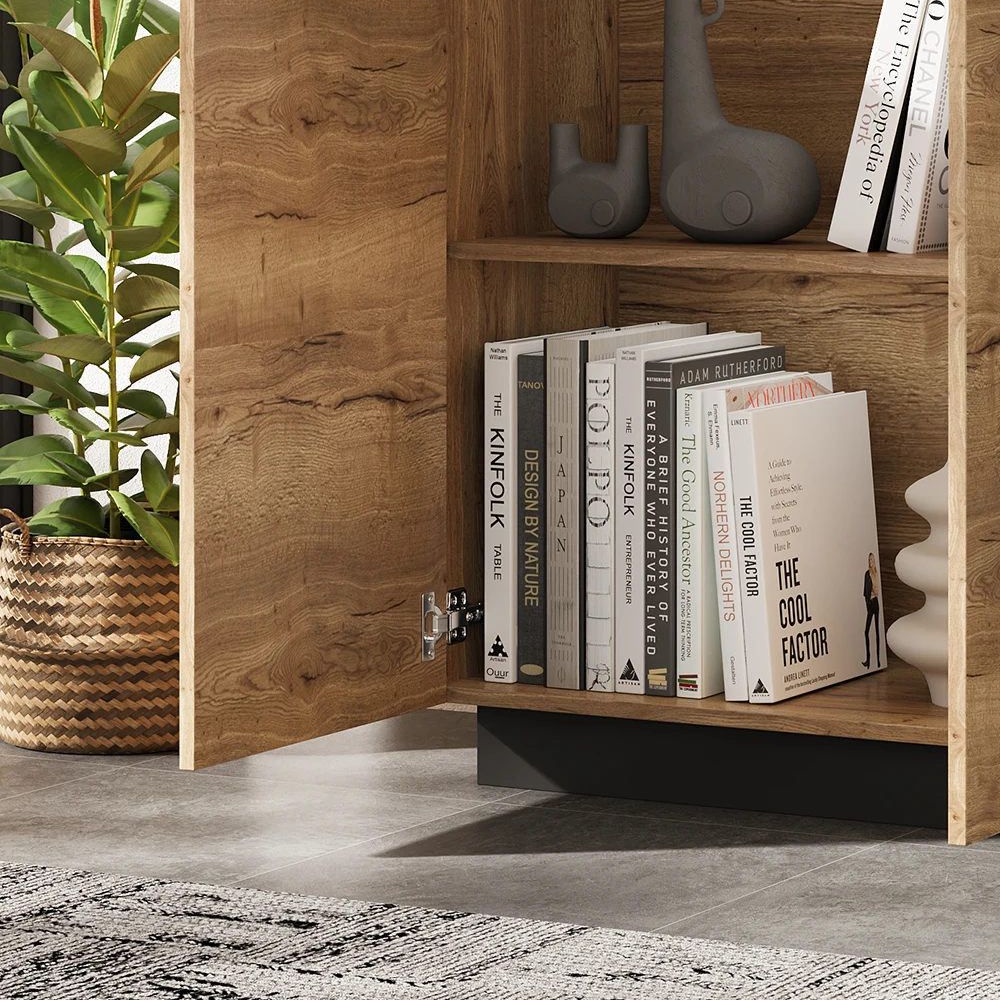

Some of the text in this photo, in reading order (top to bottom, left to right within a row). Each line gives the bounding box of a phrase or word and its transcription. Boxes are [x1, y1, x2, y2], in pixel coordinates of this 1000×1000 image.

[856, 48, 891, 146] New York
[859, 0, 920, 204] The Encyclopedia of
[909, 30, 940, 136] CHANEL
[680, 355, 783, 385] ADAM RUTHERFORD
[587, 377, 611, 528] POLPO
[682, 434, 696, 464] The
[772, 459, 786, 469] Guide
[490, 393, 505, 580] THE KINFOLK TABLE
[556, 435, 567, 553] JAPAN
[623, 444, 635, 516] KINFOLK
[682, 469, 696, 512] Good
[769, 472, 791, 483] Achieving
[769, 485, 791, 497] Effortless
[771, 499, 798, 511] with Secrets
[772, 516, 783, 525] from
[524, 449, 539, 607] DESIGN BY NATURE
[646, 400, 656, 655] EVERYONE WHO EVER LIVED
[659, 435, 668, 622] A BRIEF HISTORY OF
[713, 471, 736, 622] NORHERN DELIGHTS
[739, 496, 759, 597] THE COOL FACTOR
[773, 525, 802, 538] Women Who
[774, 541, 792, 552] Have It
[682, 517, 696, 585] Ancestor
[775, 557, 800, 591] THE
[779, 593, 812, 629] COOL
[781, 626, 829, 667] FACTOR
[486, 667, 509, 677] Ouur
[783, 669, 810, 683] ANDREA LINETT
